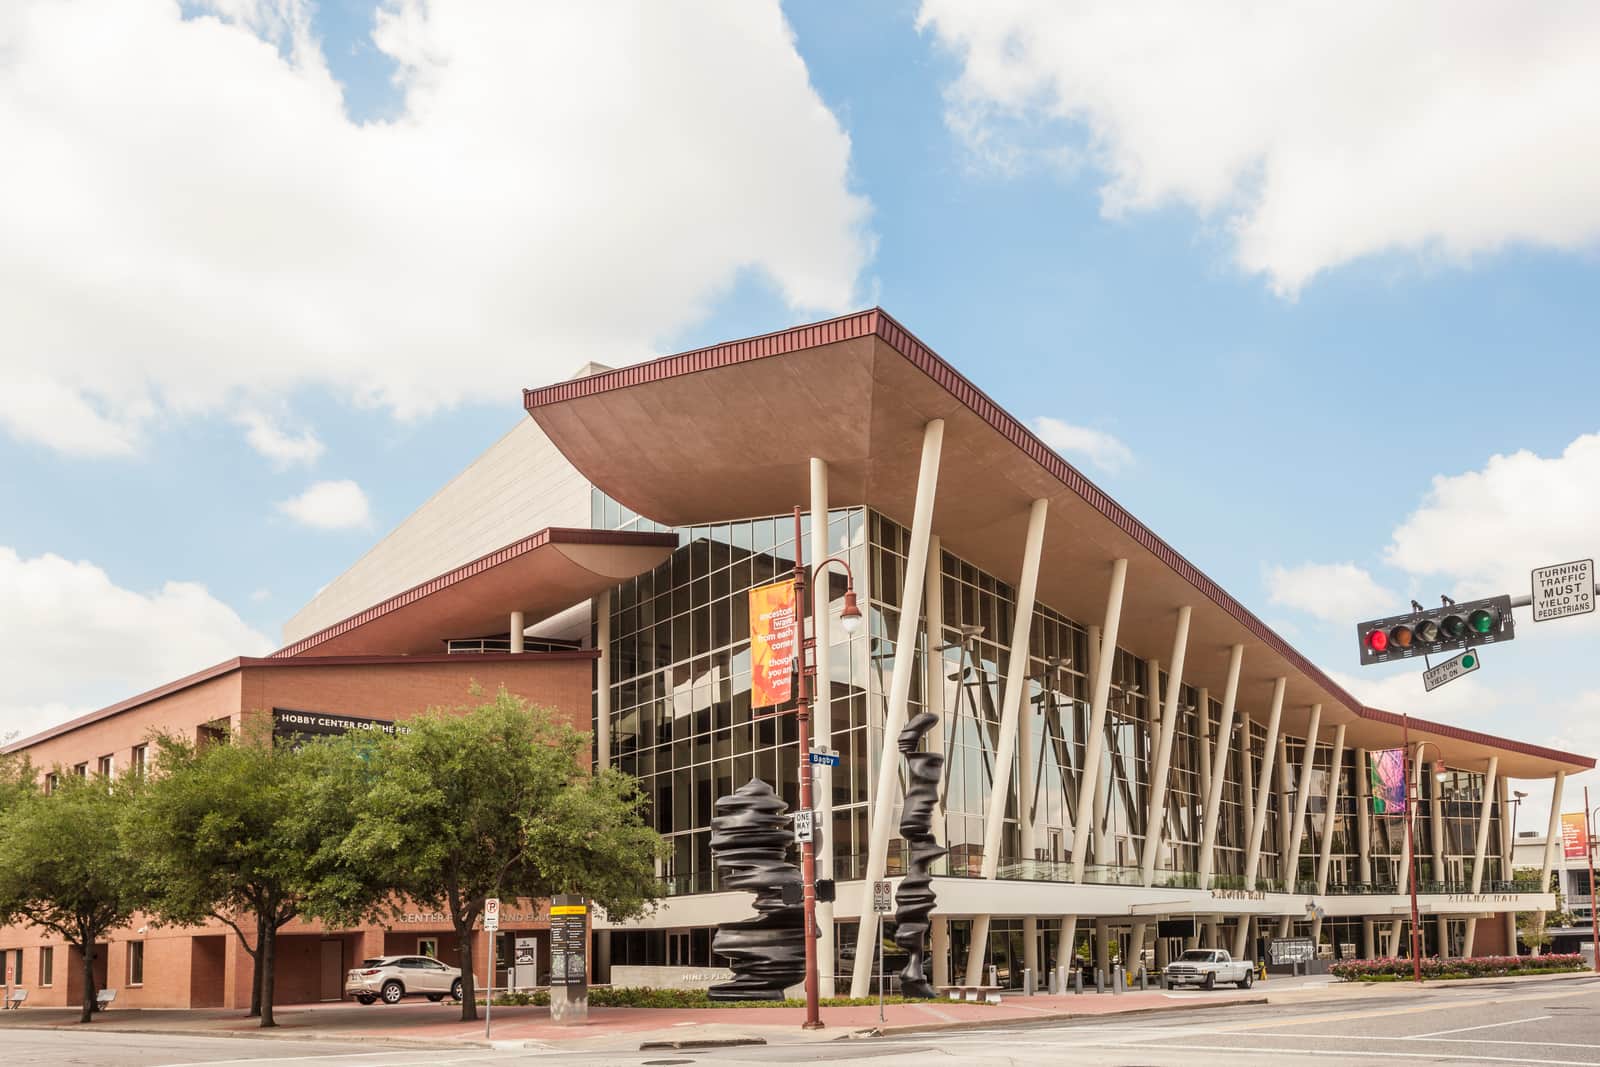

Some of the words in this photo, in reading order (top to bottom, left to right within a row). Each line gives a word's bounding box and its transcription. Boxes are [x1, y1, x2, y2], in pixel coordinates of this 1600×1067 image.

[1538, 563, 1587, 578] TURNING
[1540, 573, 1586, 587] TRAFFIC
[1544, 582, 1582, 598] MUST
[1539, 596, 1570, 608] YIELD
[1574, 593, 1589, 602] TO
[1538, 602, 1590, 618] PEDESTRIANS
[777, 628, 793, 640] each
[768, 668, 781, 679] you
[1426, 668, 1441, 680] LEFT
[1442, 660, 1458, 672] TURN
[1431, 674, 1448, 686] YIELD
[1449, 669, 1458, 677] ON
[281, 714, 316, 725] HOBBY
[318, 718, 355, 729] CENTER
[357, 722, 375, 731] FOR
[813, 754, 835, 766] Bagby
[797, 812, 810, 821] ONE
[797, 822, 810, 830] WAY
[400, 913, 444, 923] CENTER
